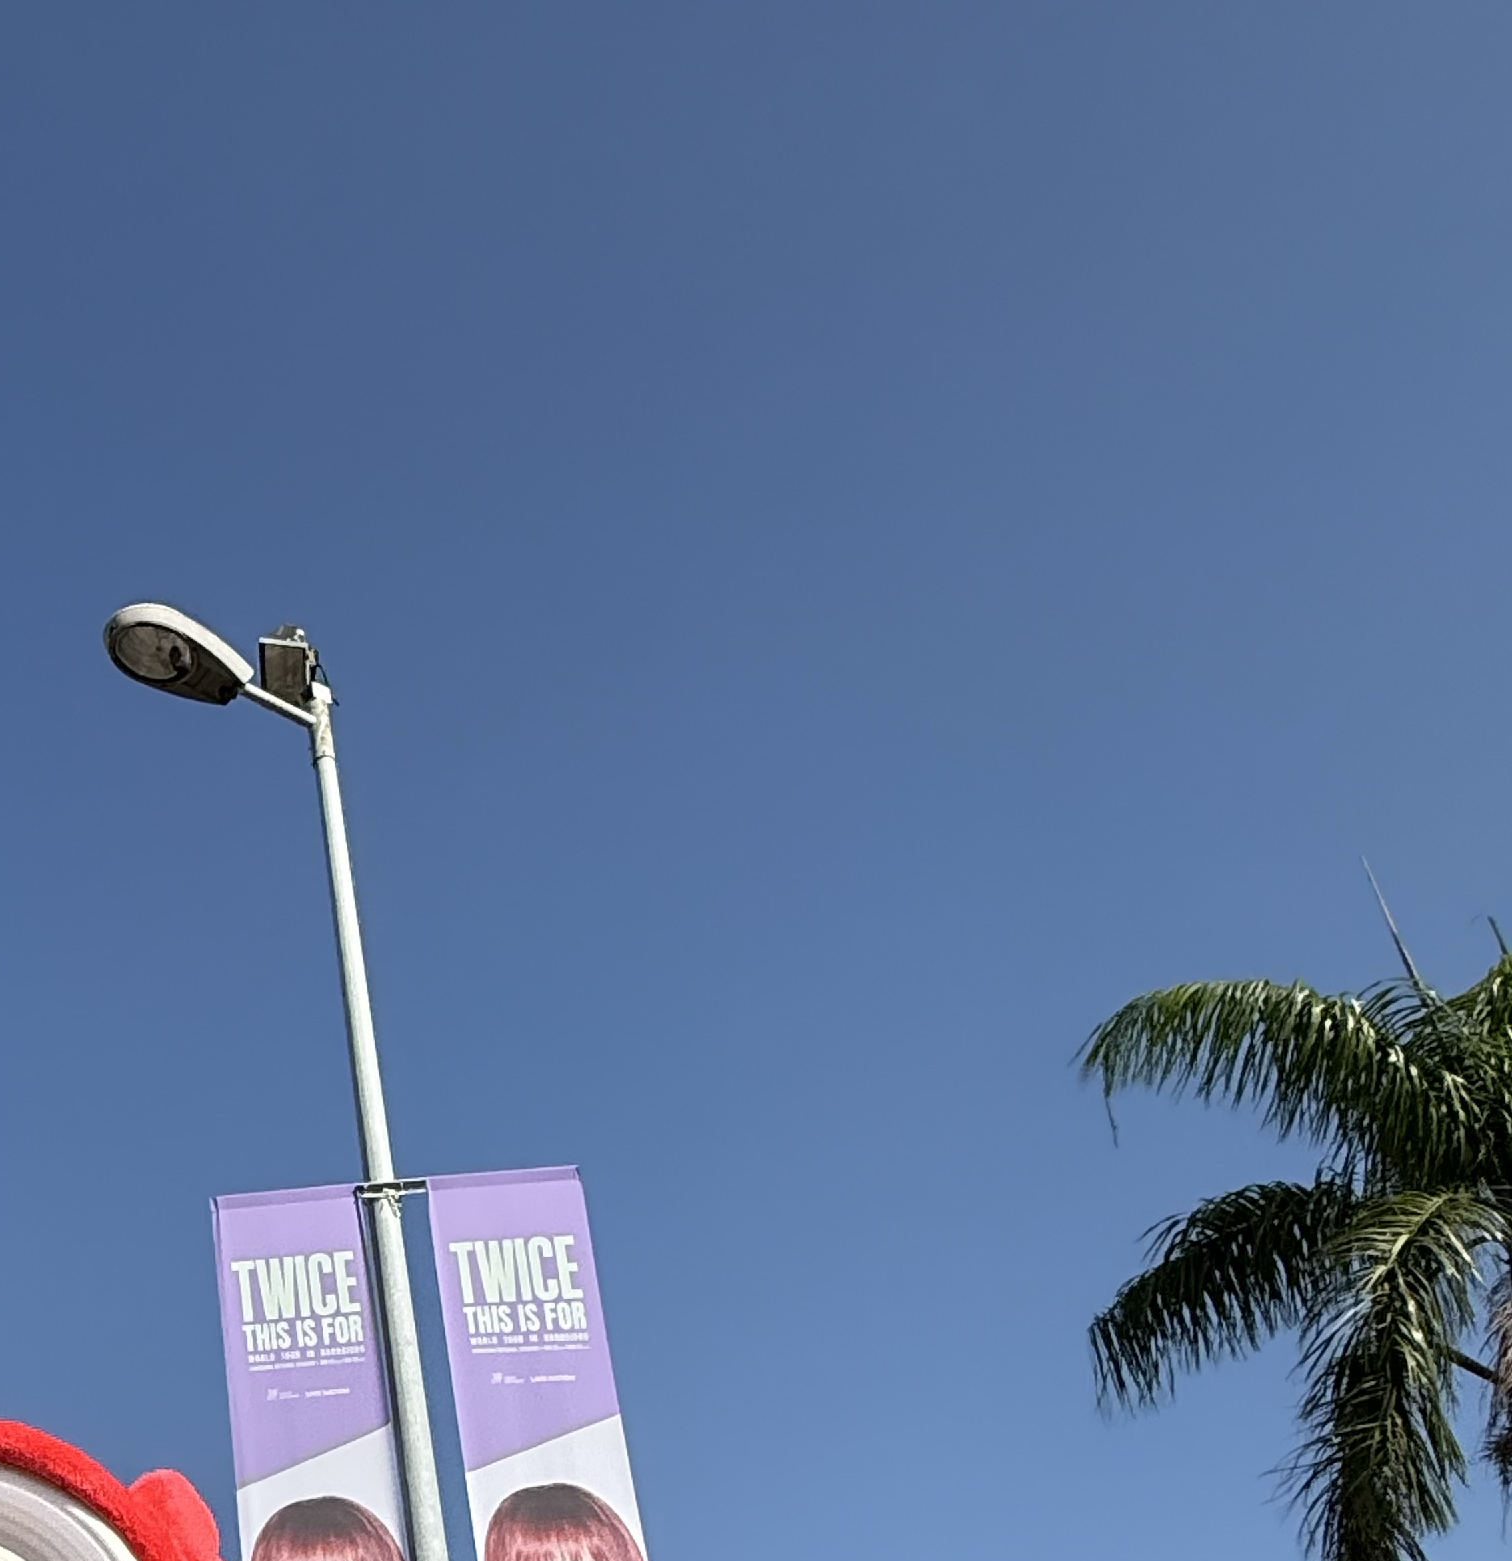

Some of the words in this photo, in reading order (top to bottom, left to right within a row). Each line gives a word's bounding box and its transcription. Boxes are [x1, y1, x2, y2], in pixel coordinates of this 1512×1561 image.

[231, 1250, 361, 1322] TWICE
[449, 1235, 584, 1304] TWICE
[242, 1321, 291, 1352] THIS
[295, 1319, 318, 1347] IS
[321, 1315, 364, 1345] FOR
[463, 1305, 514, 1334] THIS
[517, 1303, 540, 1332] IS
[543, 1301, 587, 1330] FOR
